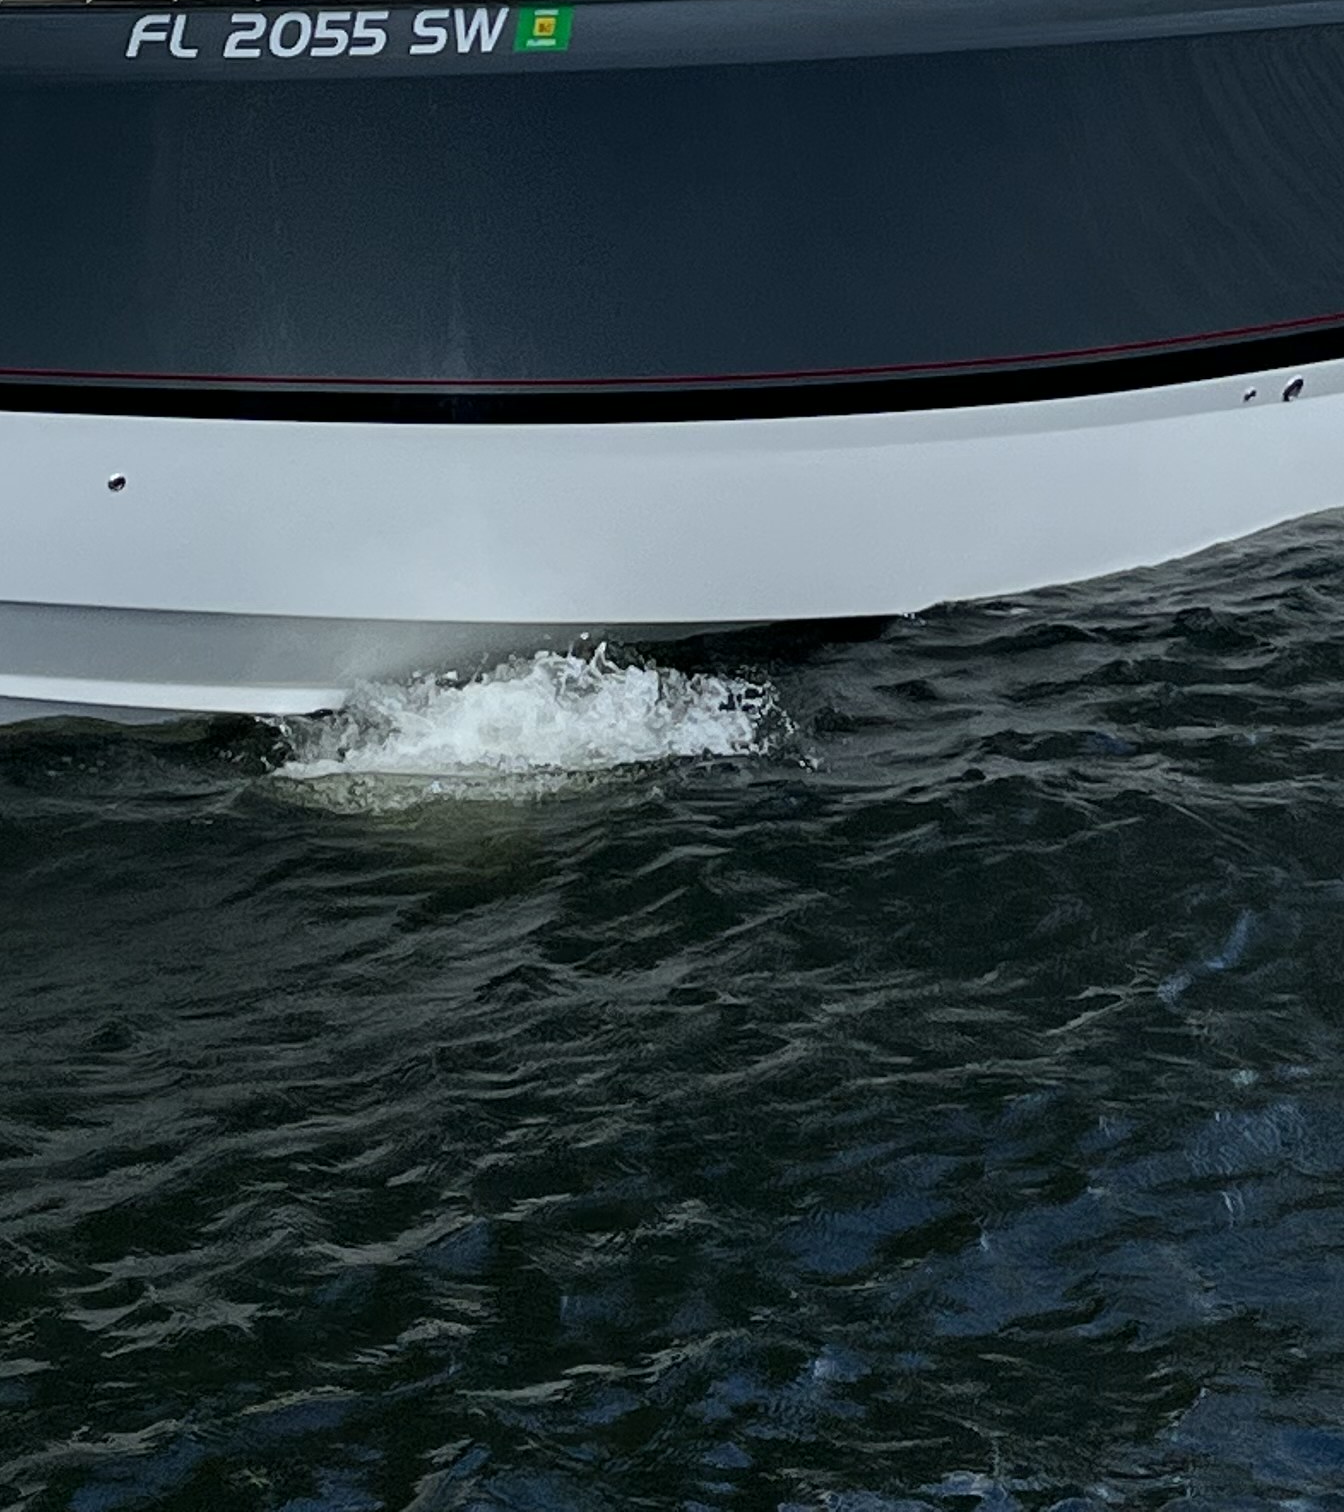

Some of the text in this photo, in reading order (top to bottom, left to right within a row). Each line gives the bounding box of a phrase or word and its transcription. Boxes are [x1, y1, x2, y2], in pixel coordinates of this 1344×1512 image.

[125, 7, 510, 58] FL 2055 SW
